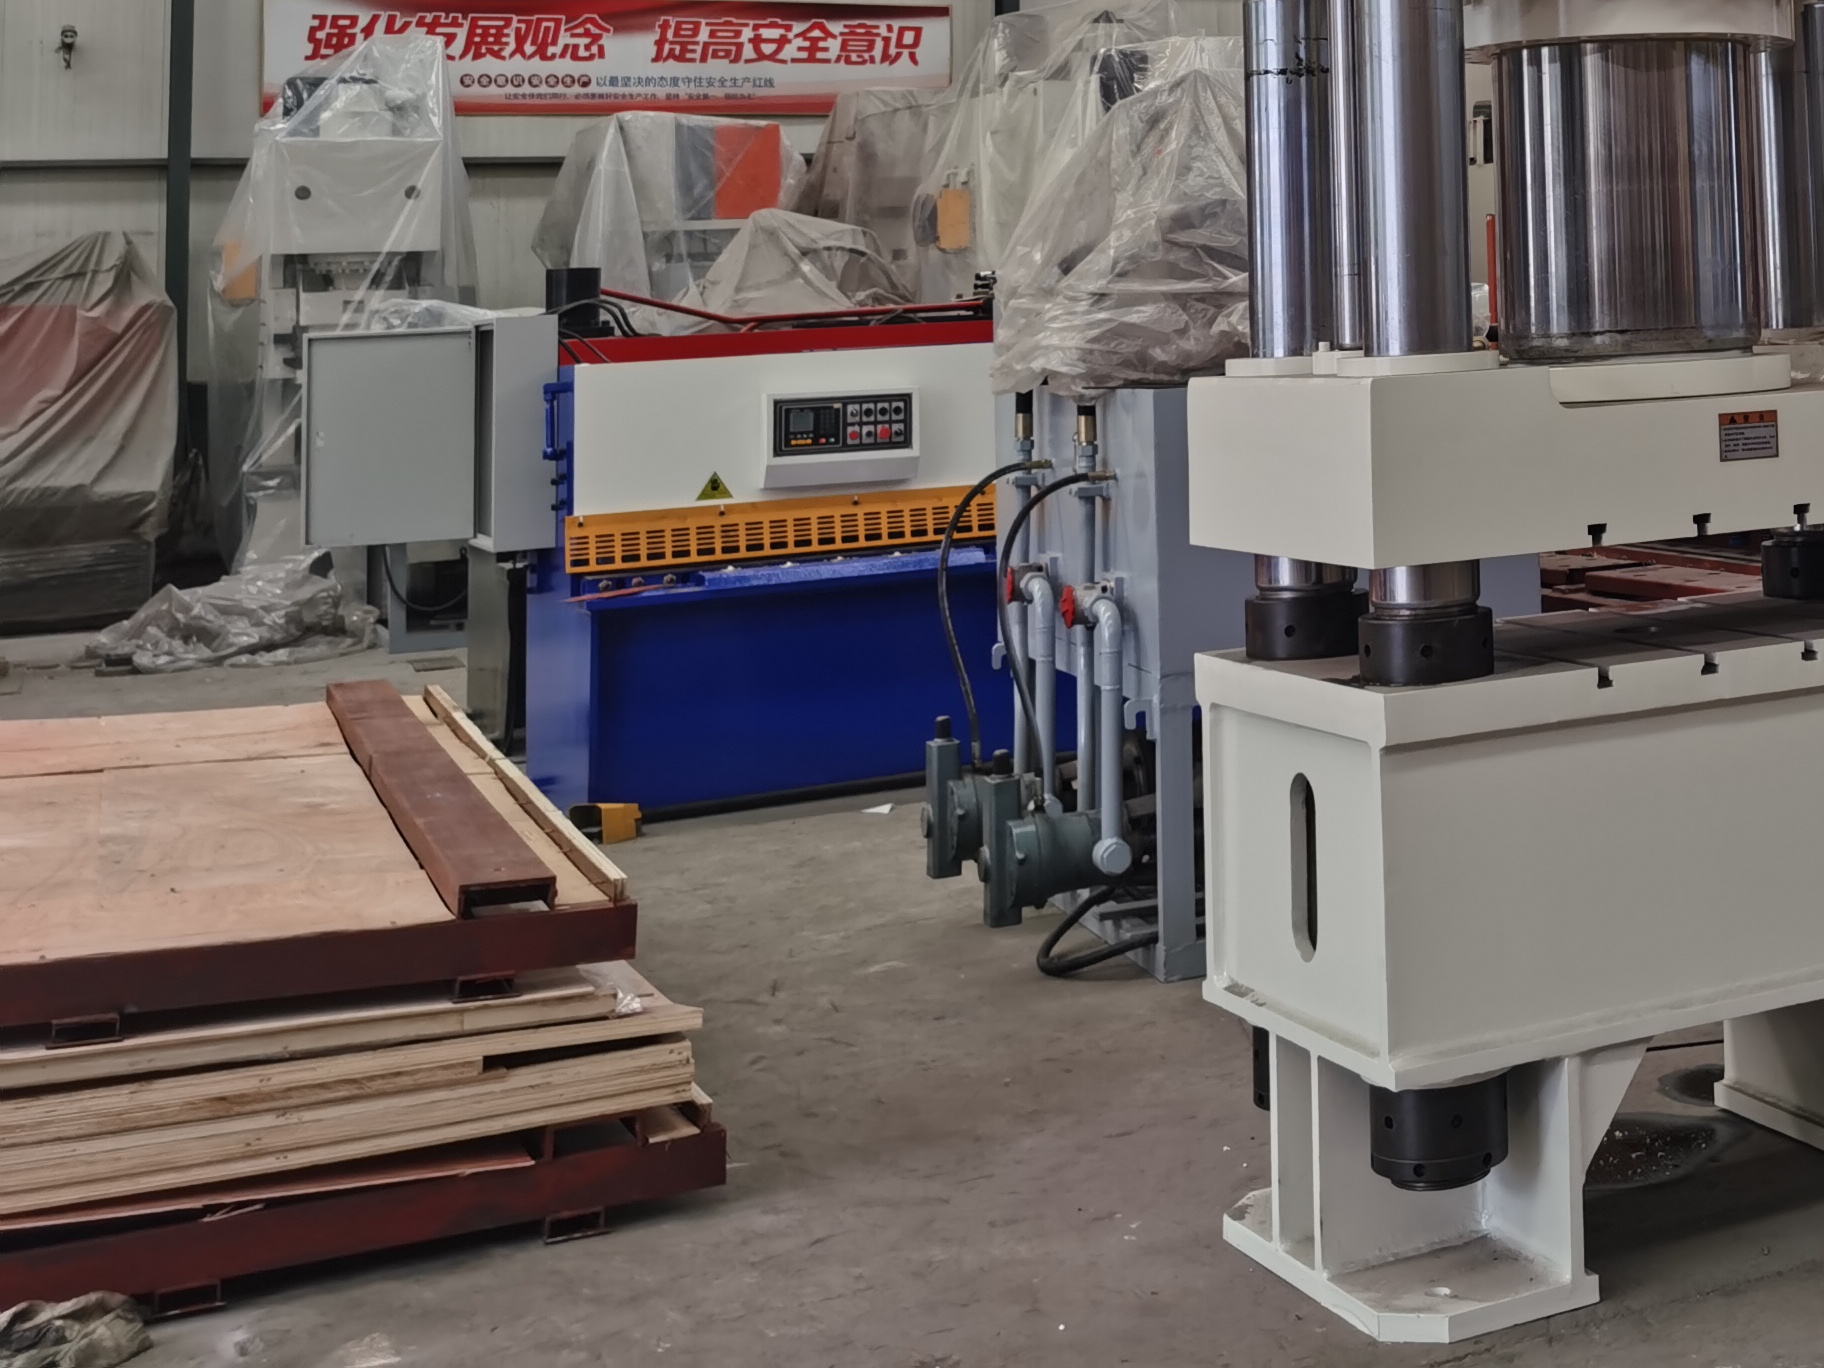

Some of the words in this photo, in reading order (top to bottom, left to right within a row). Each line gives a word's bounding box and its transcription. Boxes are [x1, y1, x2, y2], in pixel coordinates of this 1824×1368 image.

[650, 17, 924, 67] 提高安全意识
